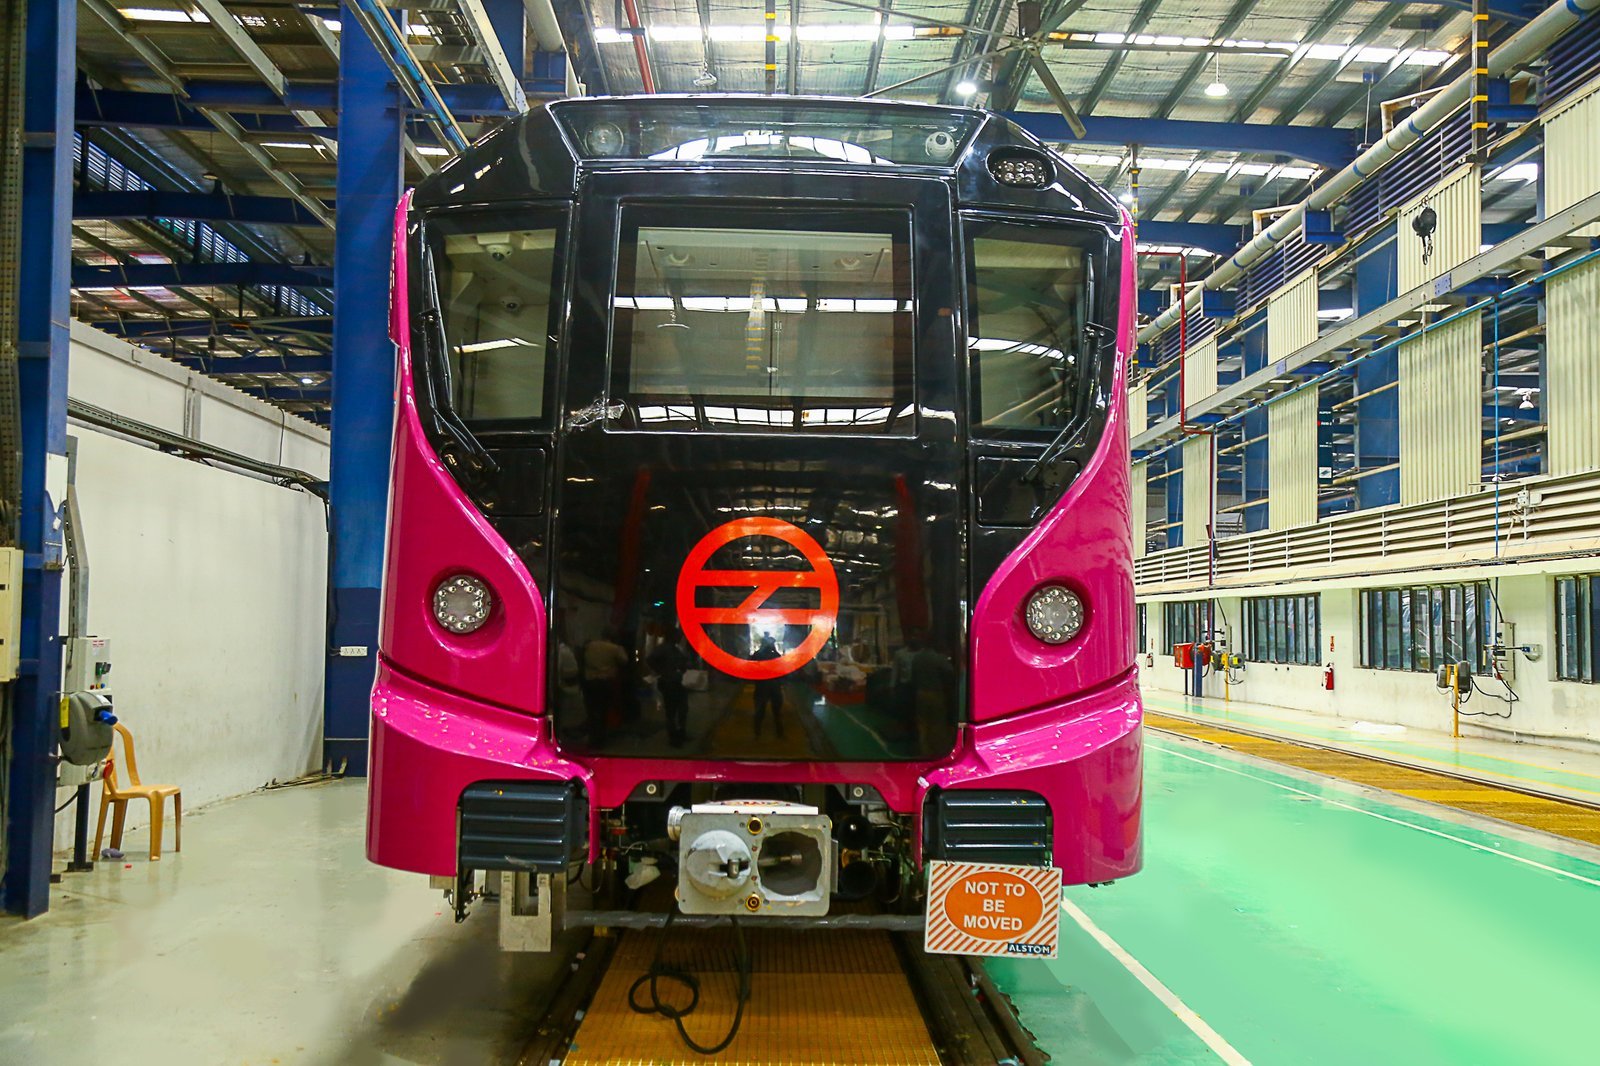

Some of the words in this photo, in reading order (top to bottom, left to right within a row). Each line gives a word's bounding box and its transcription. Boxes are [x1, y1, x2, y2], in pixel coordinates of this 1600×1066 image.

[965, 881, 999, 895] NOT
[1003, 883, 1026, 897] TO
[983, 899, 1005, 913] BE
[963, 915, 1023, 931] MOVED
[1008, 944, 1050, 954] ALSTOM
